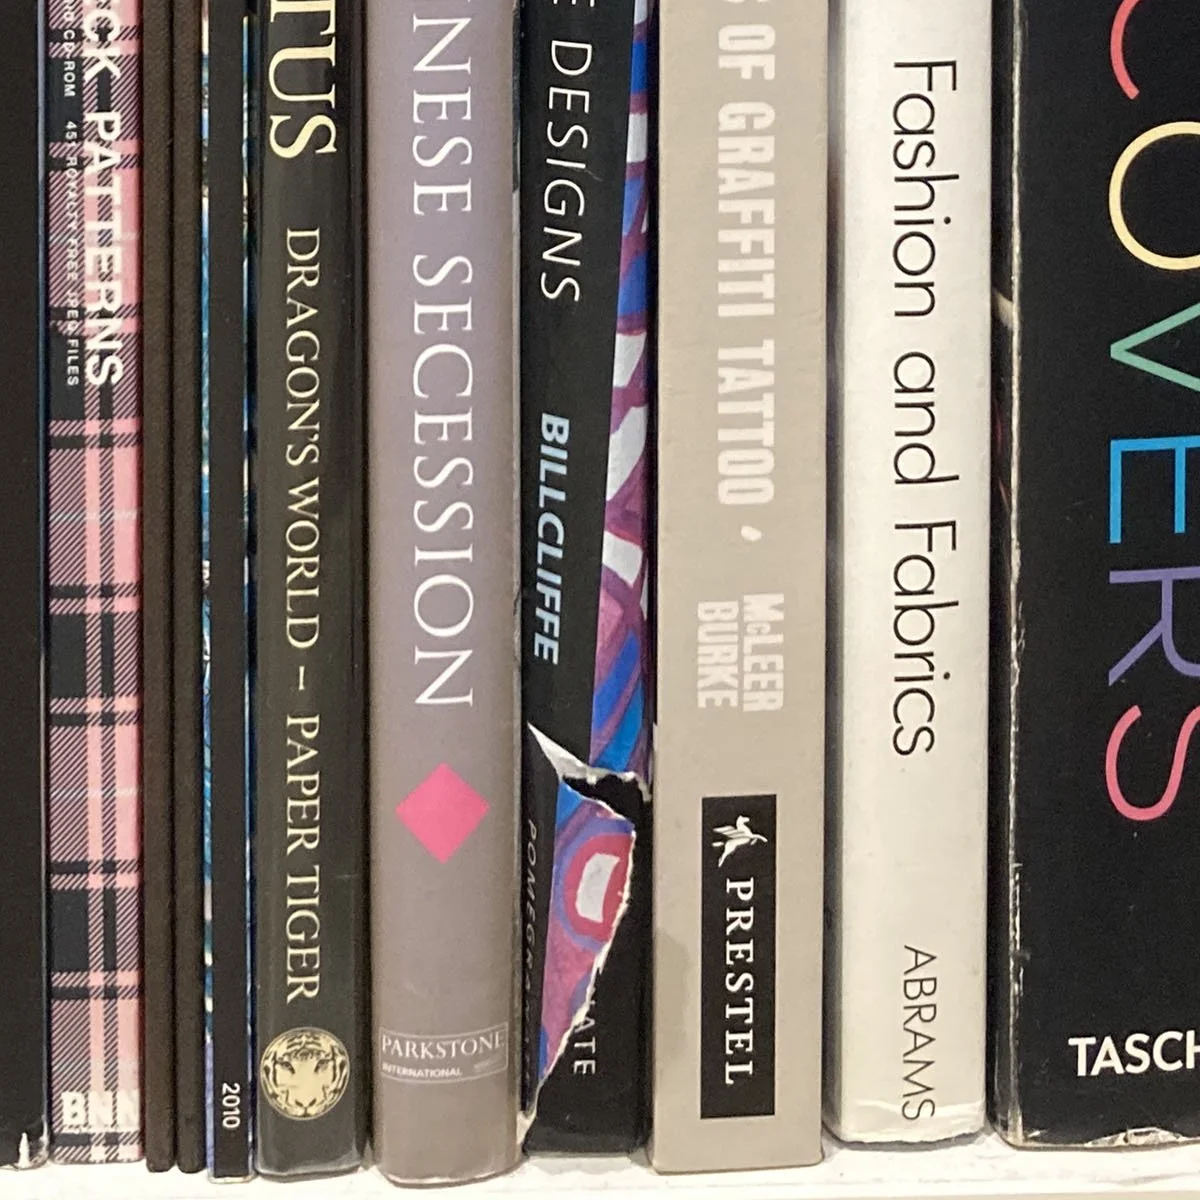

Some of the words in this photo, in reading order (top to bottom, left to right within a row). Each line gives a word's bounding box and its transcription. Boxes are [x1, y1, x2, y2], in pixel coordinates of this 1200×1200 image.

[717, 23, 777, 82] OF
[84, 111, 124, 387] PATTERNS
[540, 39, 593, 302] DESIGNS
[717, 101, 776, 318] GRAFFITI
[892, 59, 960, 318] Fashion
[66, 337, 80, 387] FILES
[286, 227, 320, 467] DRAGON'S
[717, 338, 776, 505] TATTOO
[893, 352, 960, 485] and
[285, 476, 320, 649] WORLD
[412, 253, 475, 708] SECESSION
[533, 412, 570, 666] BILLCLIFFE
[697, 600, 740, 710] BURKE
[742, 592, 785, 713] McLEER
[892, 519, 960, 757] Fabrics
[286, 714, 320, 857] PAPER
[287, 865, 321, 1005] TIGER
[724, 876, 755, 1086] PRESTEL
[221, 1081, 241, 1129] 2010
[381, 1030, 506, 1060] PARKSTONE
[381, 1061, 464, 1078] INTERNATIONAL
[901, 944, 938, 1121] ABRAMS
